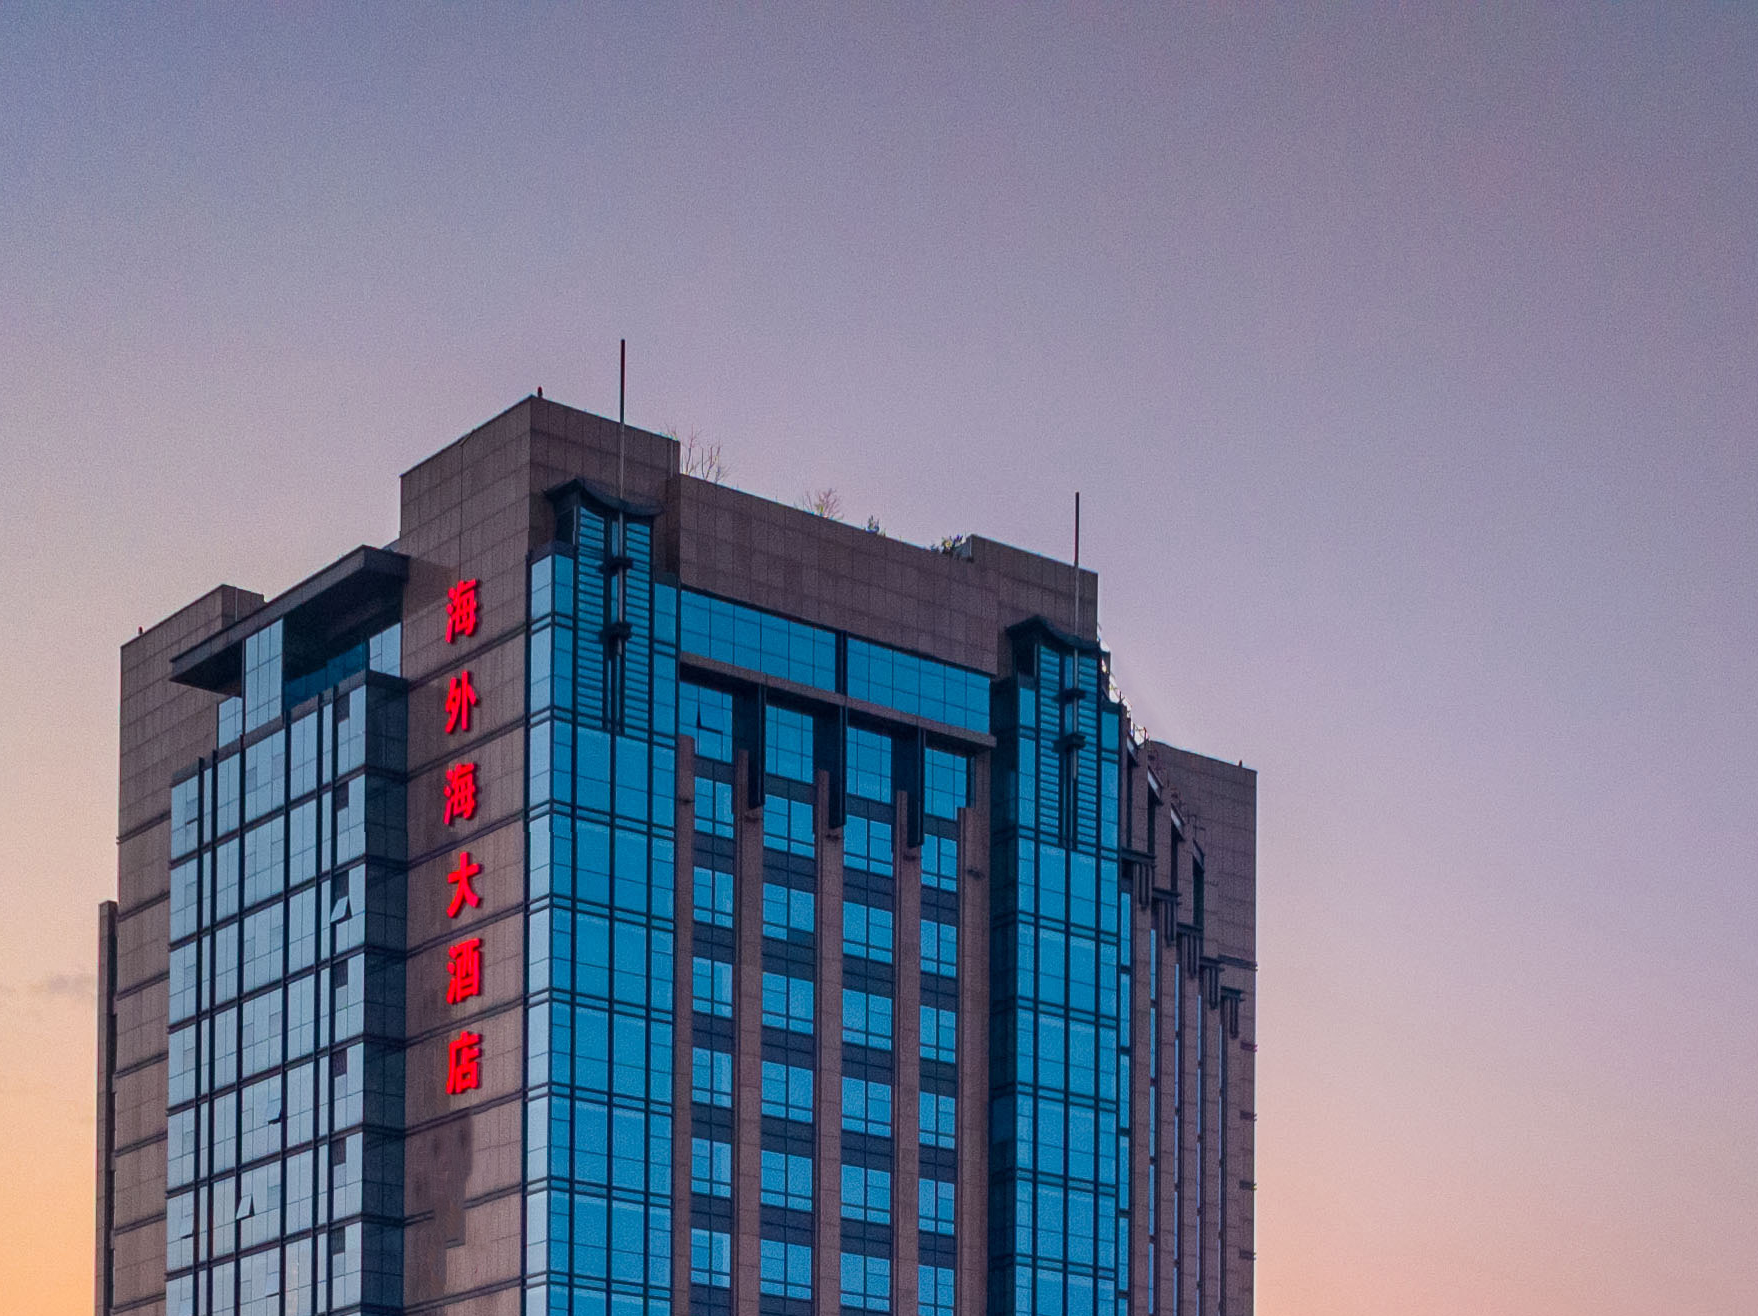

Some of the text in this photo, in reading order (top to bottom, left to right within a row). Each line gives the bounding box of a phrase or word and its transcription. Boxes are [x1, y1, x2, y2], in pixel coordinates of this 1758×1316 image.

[443, 579, 482, 1095] 海外海大酒店
